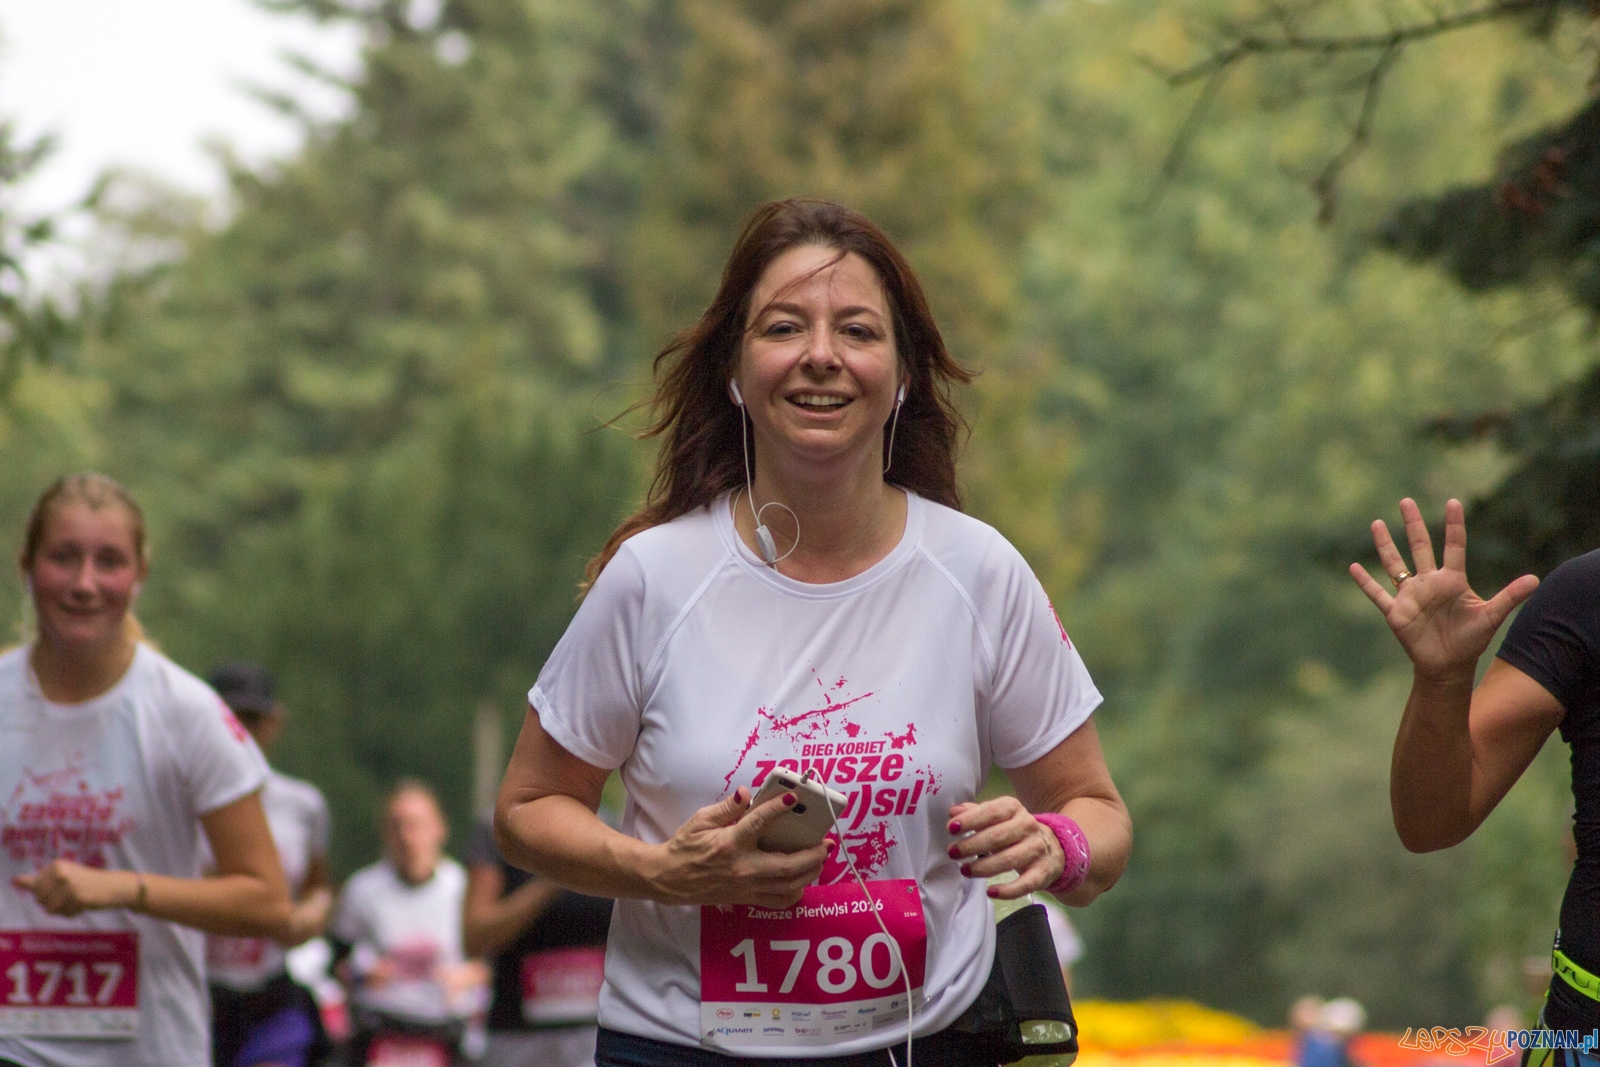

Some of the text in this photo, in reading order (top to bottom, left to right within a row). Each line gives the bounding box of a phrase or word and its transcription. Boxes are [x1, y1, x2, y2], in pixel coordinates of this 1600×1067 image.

[802, 741, 886, 757] BIEG KOBIET
[748, 899, 883, 920] Zawsze Pier(w)si 2016
[730, 932, 903, 994] 1780
[5, 961, 124, 1005] 1717
